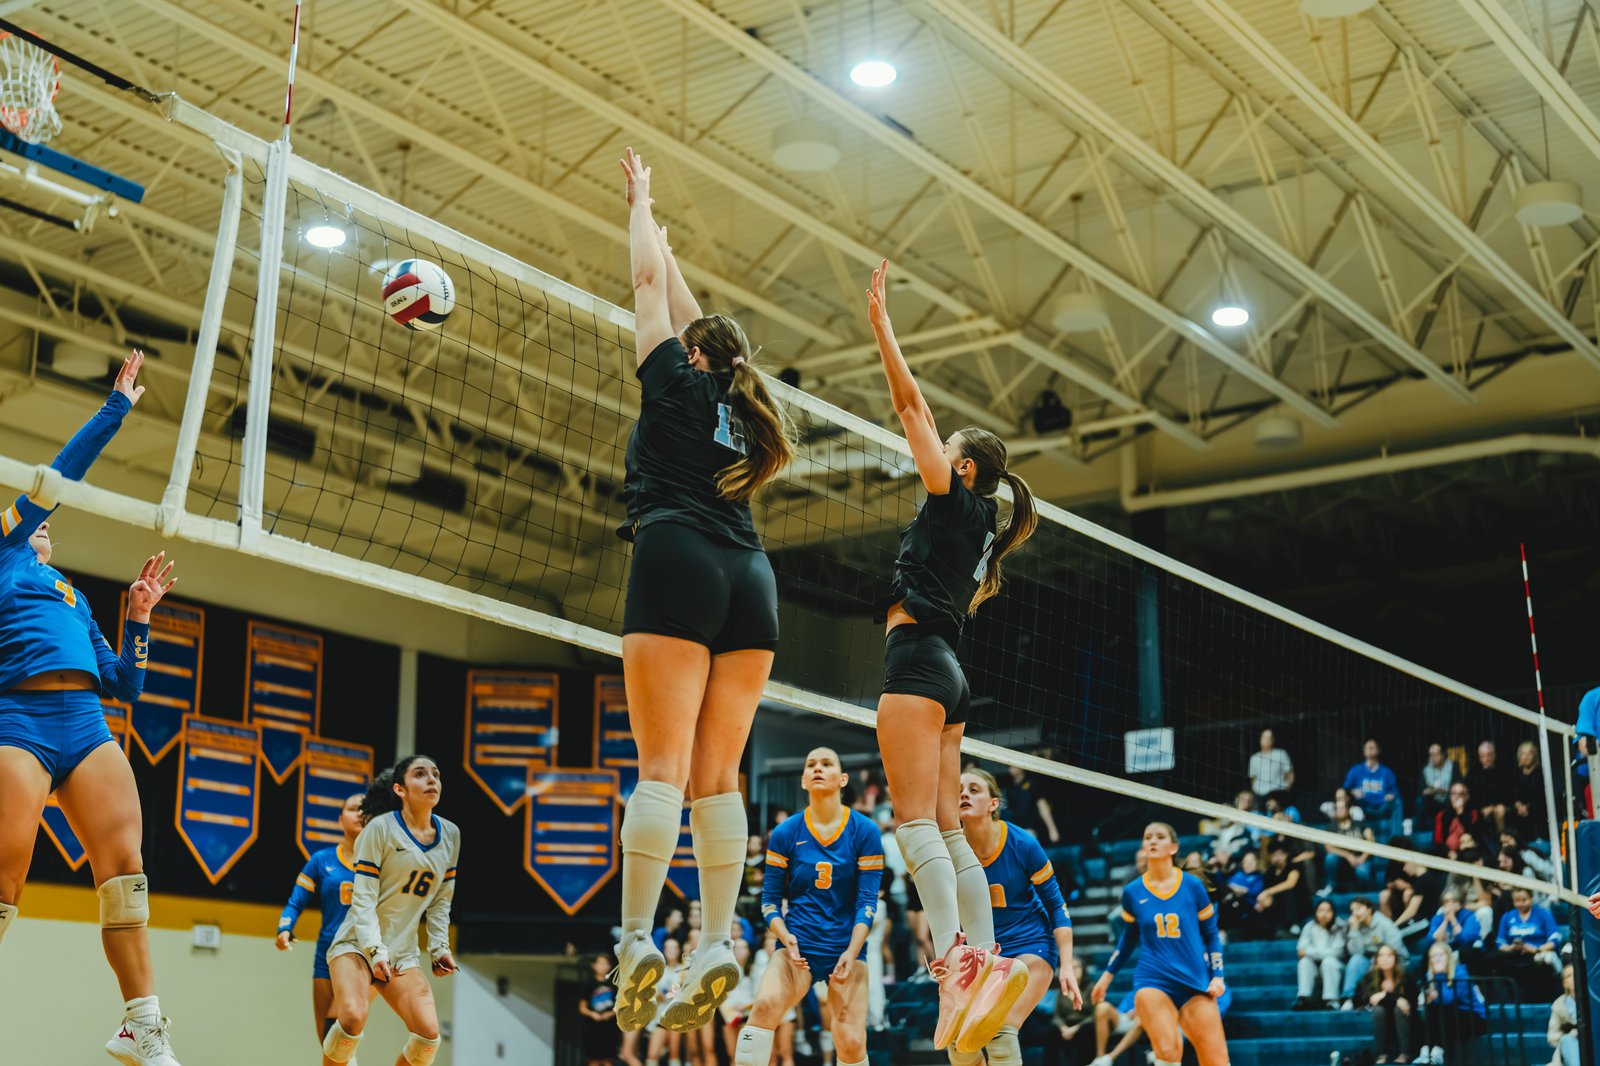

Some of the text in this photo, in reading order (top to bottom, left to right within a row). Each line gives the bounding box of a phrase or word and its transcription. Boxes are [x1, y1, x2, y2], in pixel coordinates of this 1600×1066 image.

[401, 869, 435, 898] 16
[815, 861, 833, 890] 3
[1154, 912, 1181, 938] 12
